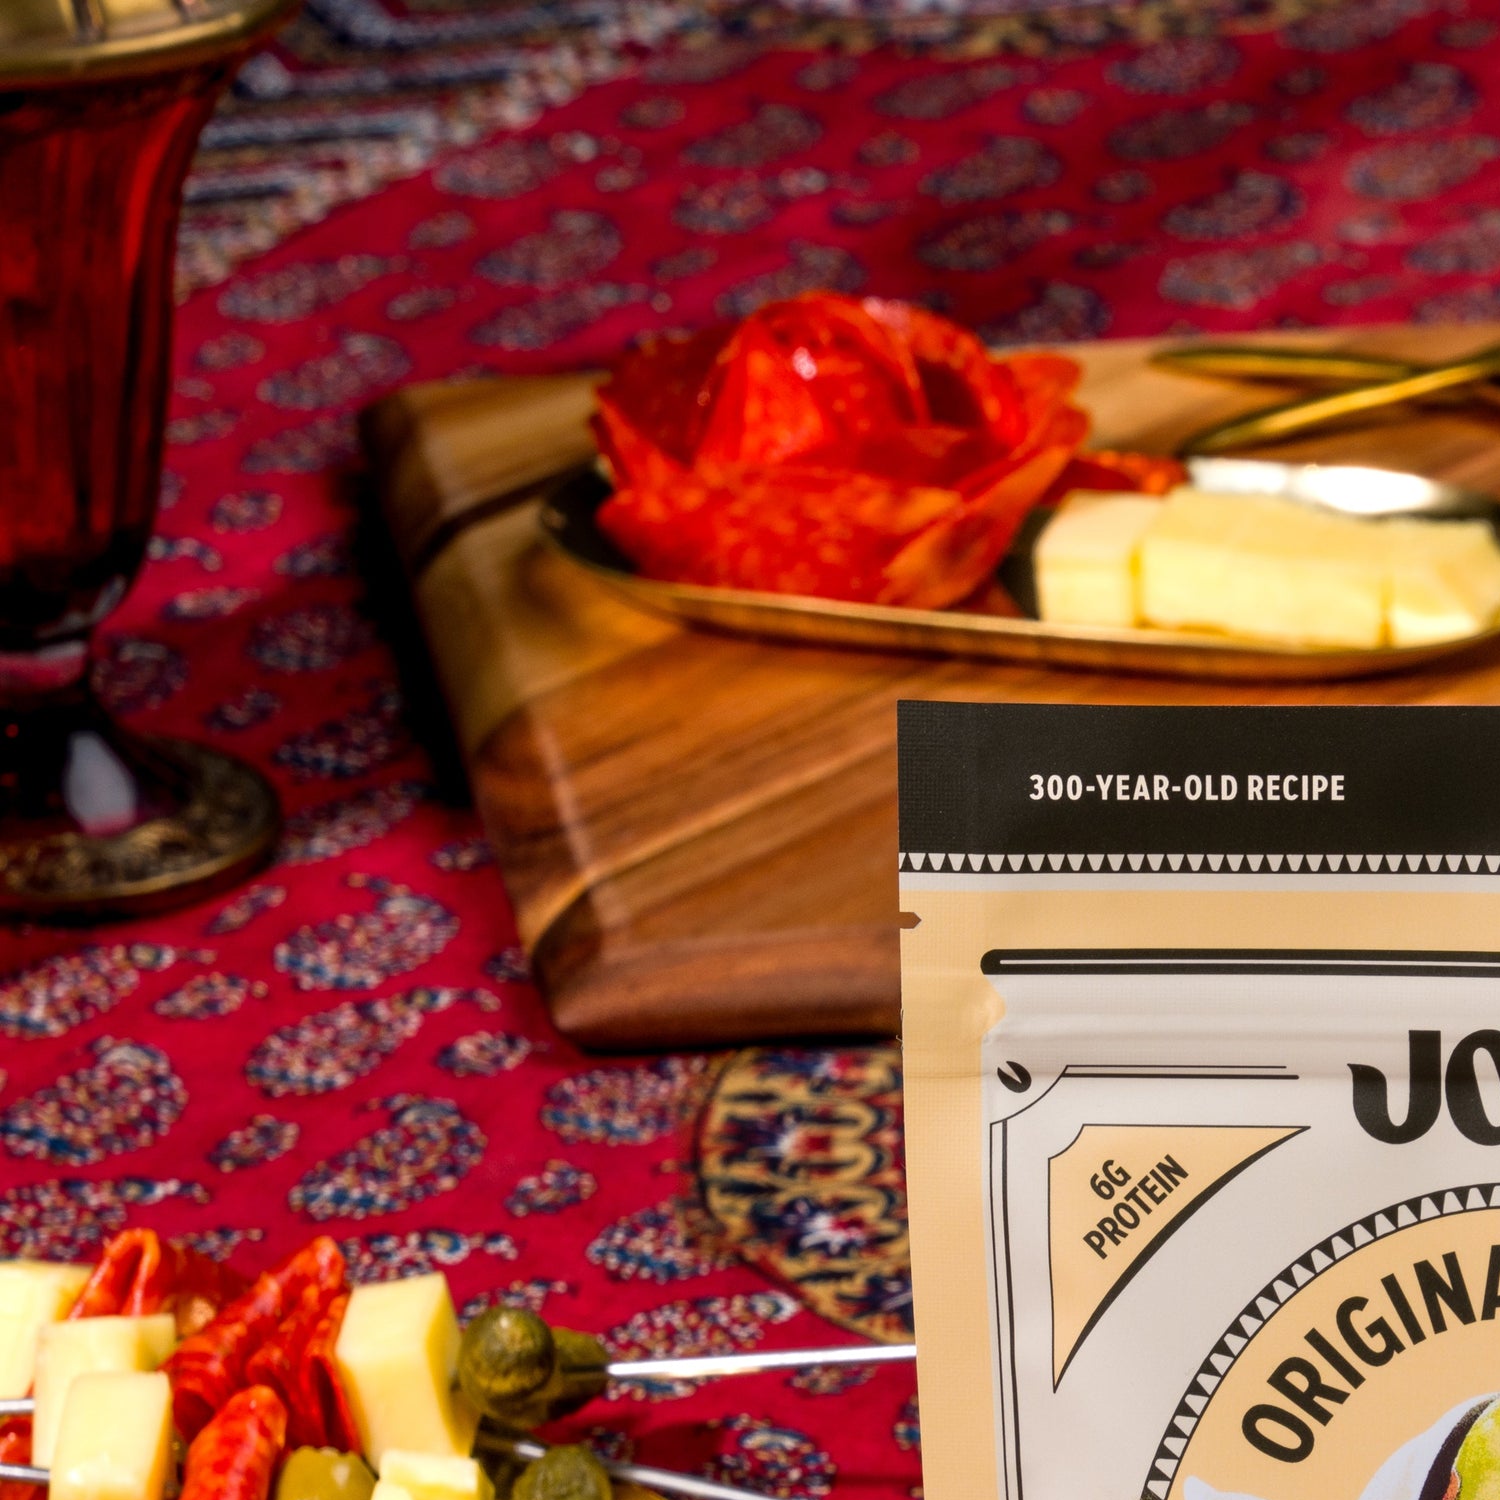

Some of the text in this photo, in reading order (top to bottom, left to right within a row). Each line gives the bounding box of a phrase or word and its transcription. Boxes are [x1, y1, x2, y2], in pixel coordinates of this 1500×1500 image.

[1030, 775, 1344, 800] 300-YEAR-OLD RECIPE
[1090, 1160, 1131, 1200] 6G
[1083, 1154, 1189, 1260] PROTEIN
